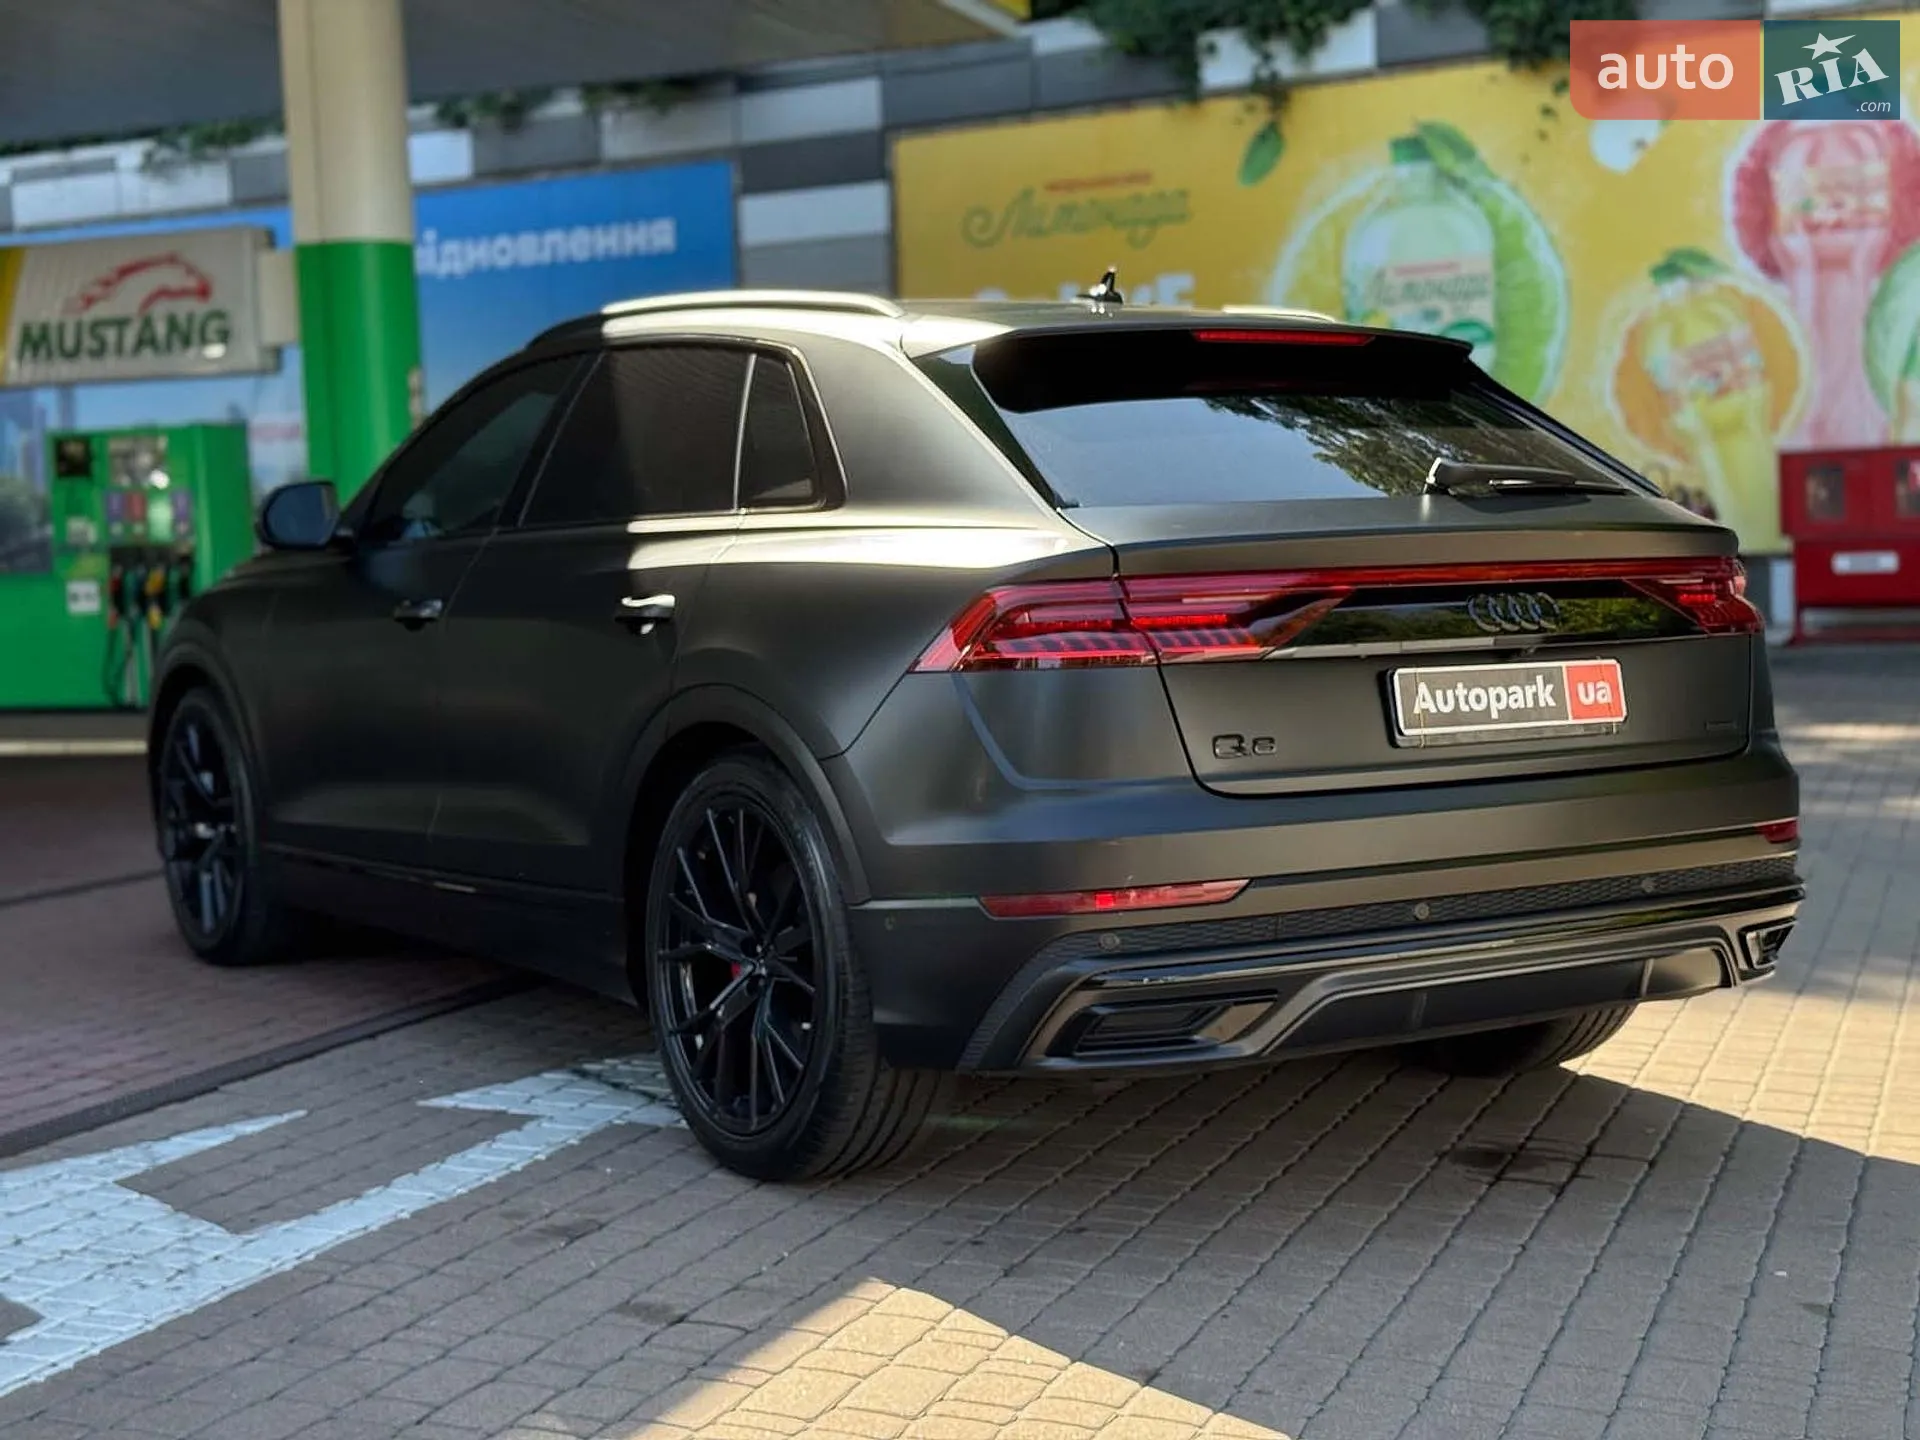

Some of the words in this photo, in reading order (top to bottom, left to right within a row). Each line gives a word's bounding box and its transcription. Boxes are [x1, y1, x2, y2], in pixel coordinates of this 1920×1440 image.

[18, 309, 232, 366] MUSTANG
[1413, 675, 1556, 719] Autopark
[1577, 680, 1614, 706] ua
